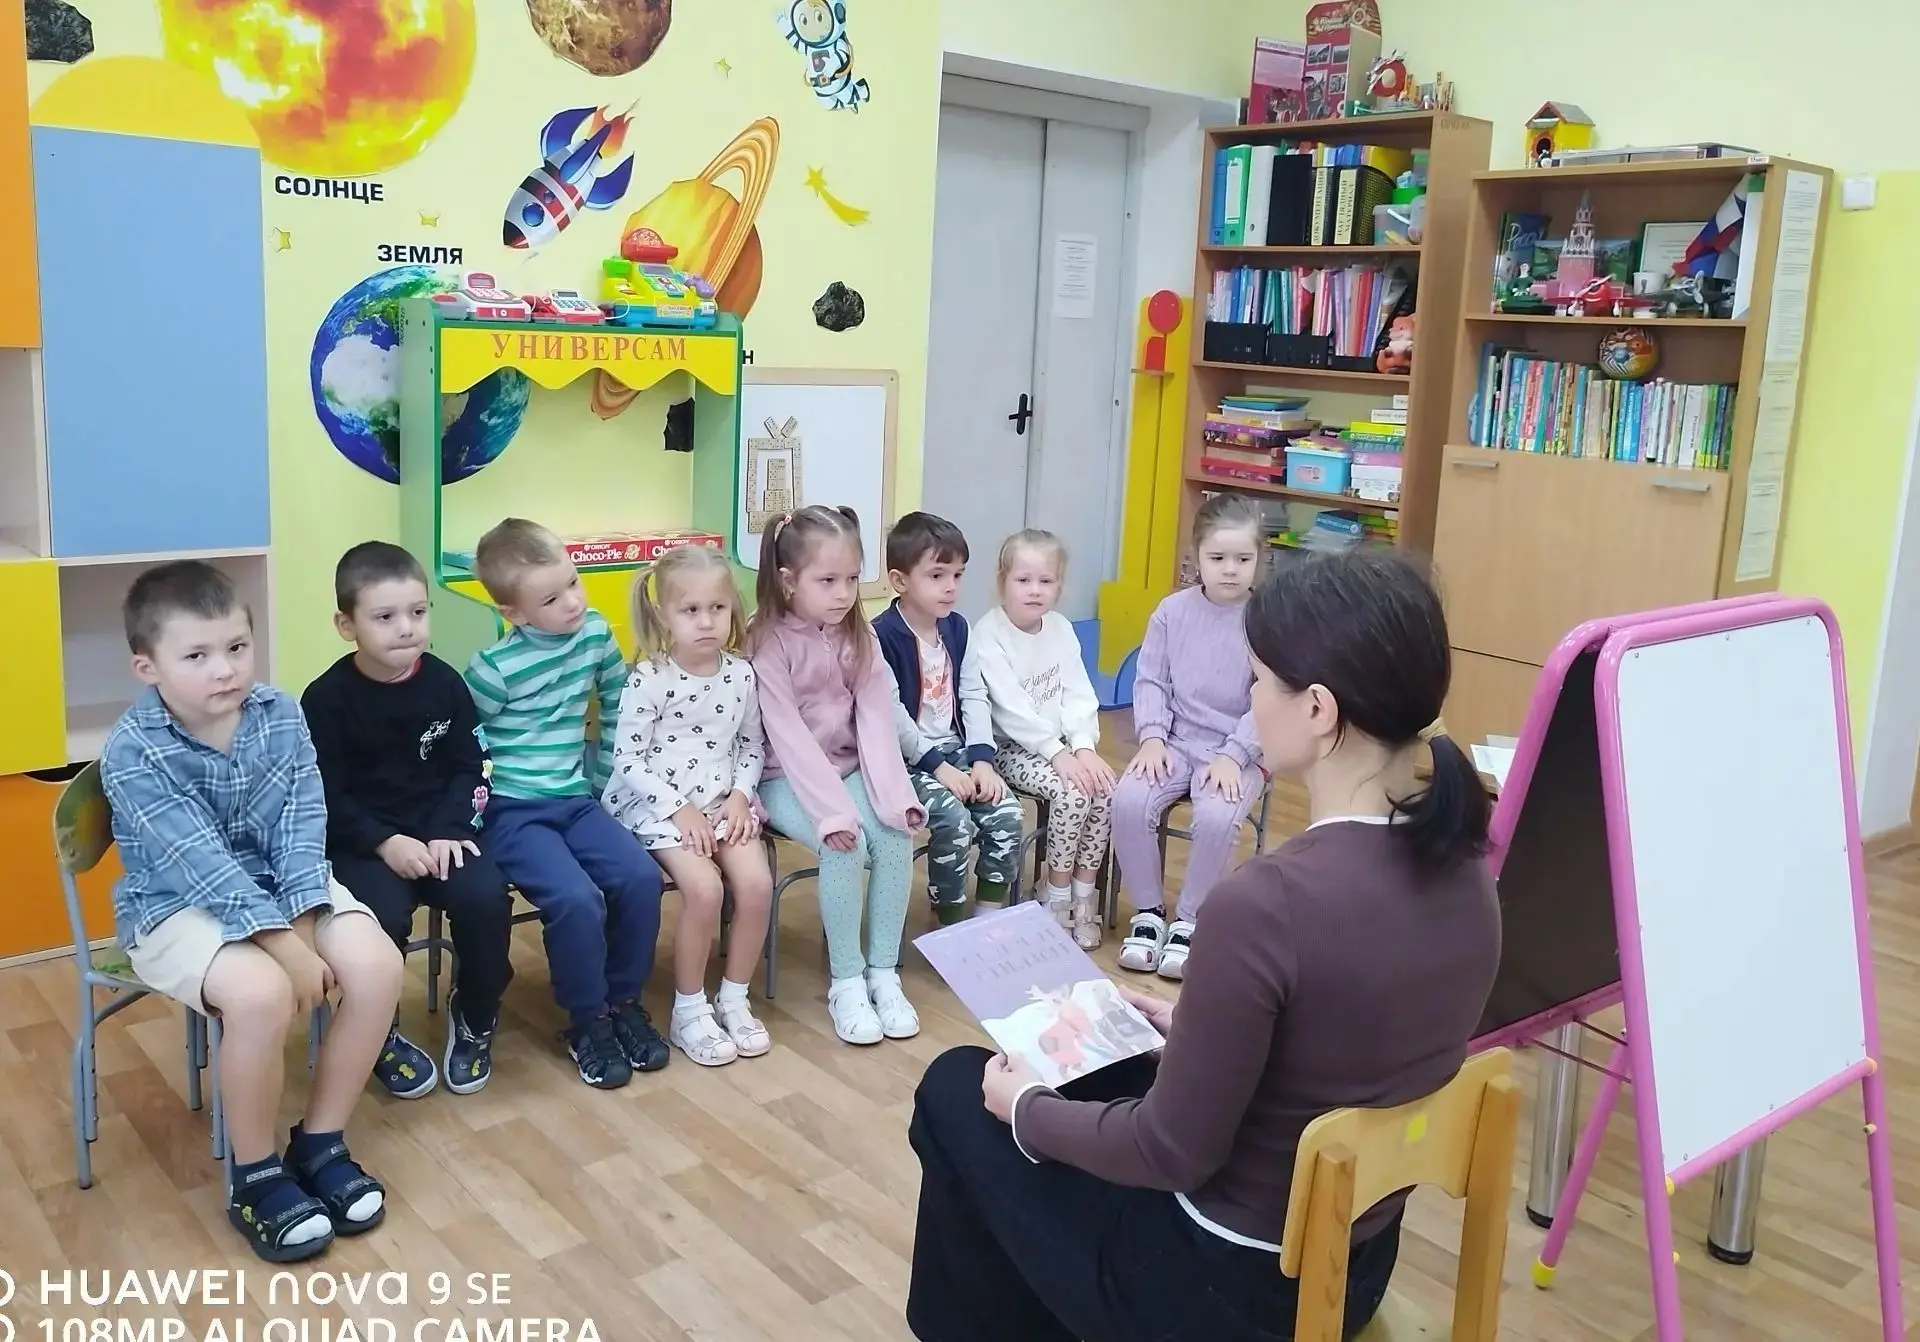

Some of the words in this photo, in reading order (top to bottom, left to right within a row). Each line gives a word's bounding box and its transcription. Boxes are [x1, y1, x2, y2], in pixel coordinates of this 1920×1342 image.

[275, 175, 384, 204] СОЛНЦЕ
[377, 244, 463, 264] ЗЕМЛЯ
[491, 333, 687, 361] УНИВЕРСАМ
